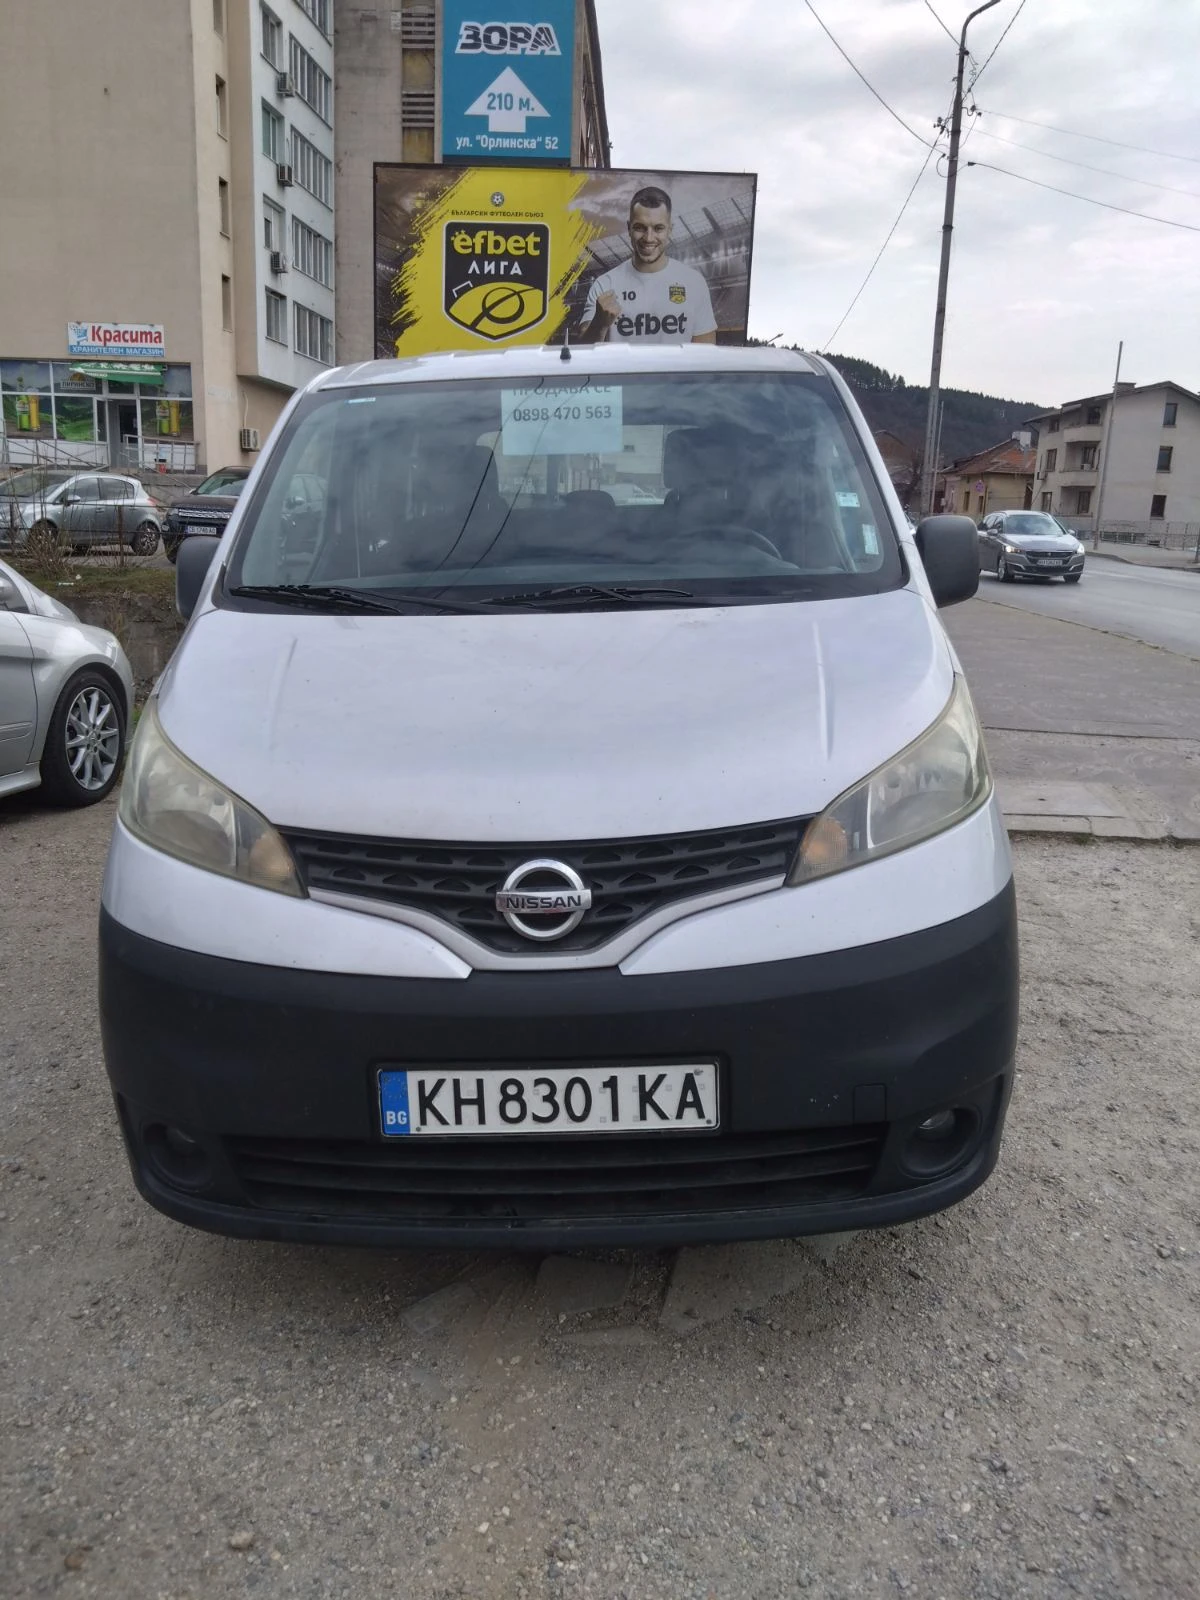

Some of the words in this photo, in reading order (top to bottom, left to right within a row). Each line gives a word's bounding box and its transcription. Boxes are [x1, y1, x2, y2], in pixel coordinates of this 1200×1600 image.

[456, 22, 561, 54] ЗОРА
[487, 92, 513, 111] 210
[518, 97, 535, 112] м.
[456, 137, 473, 150] ул.
[545, 136, 559, 150] 52
[451, 229, 541, 256] efbet
[468, 260, 523, 276] ЛИГА
[622, 290, 637, 301] 10
[615, 312, 688, 337] efbet
[91, 325, 162, 346] Красита
[72, 346, 124, 354] ХРАНИТЕЛЕН
[513, 407, 550, 421] 0898
[553, 406, 581, 420] 470
[585, 405, 612, 419] 563
[506, 895, 581, 909] NISSAN
[386, 1110, 408, 1125] BG
